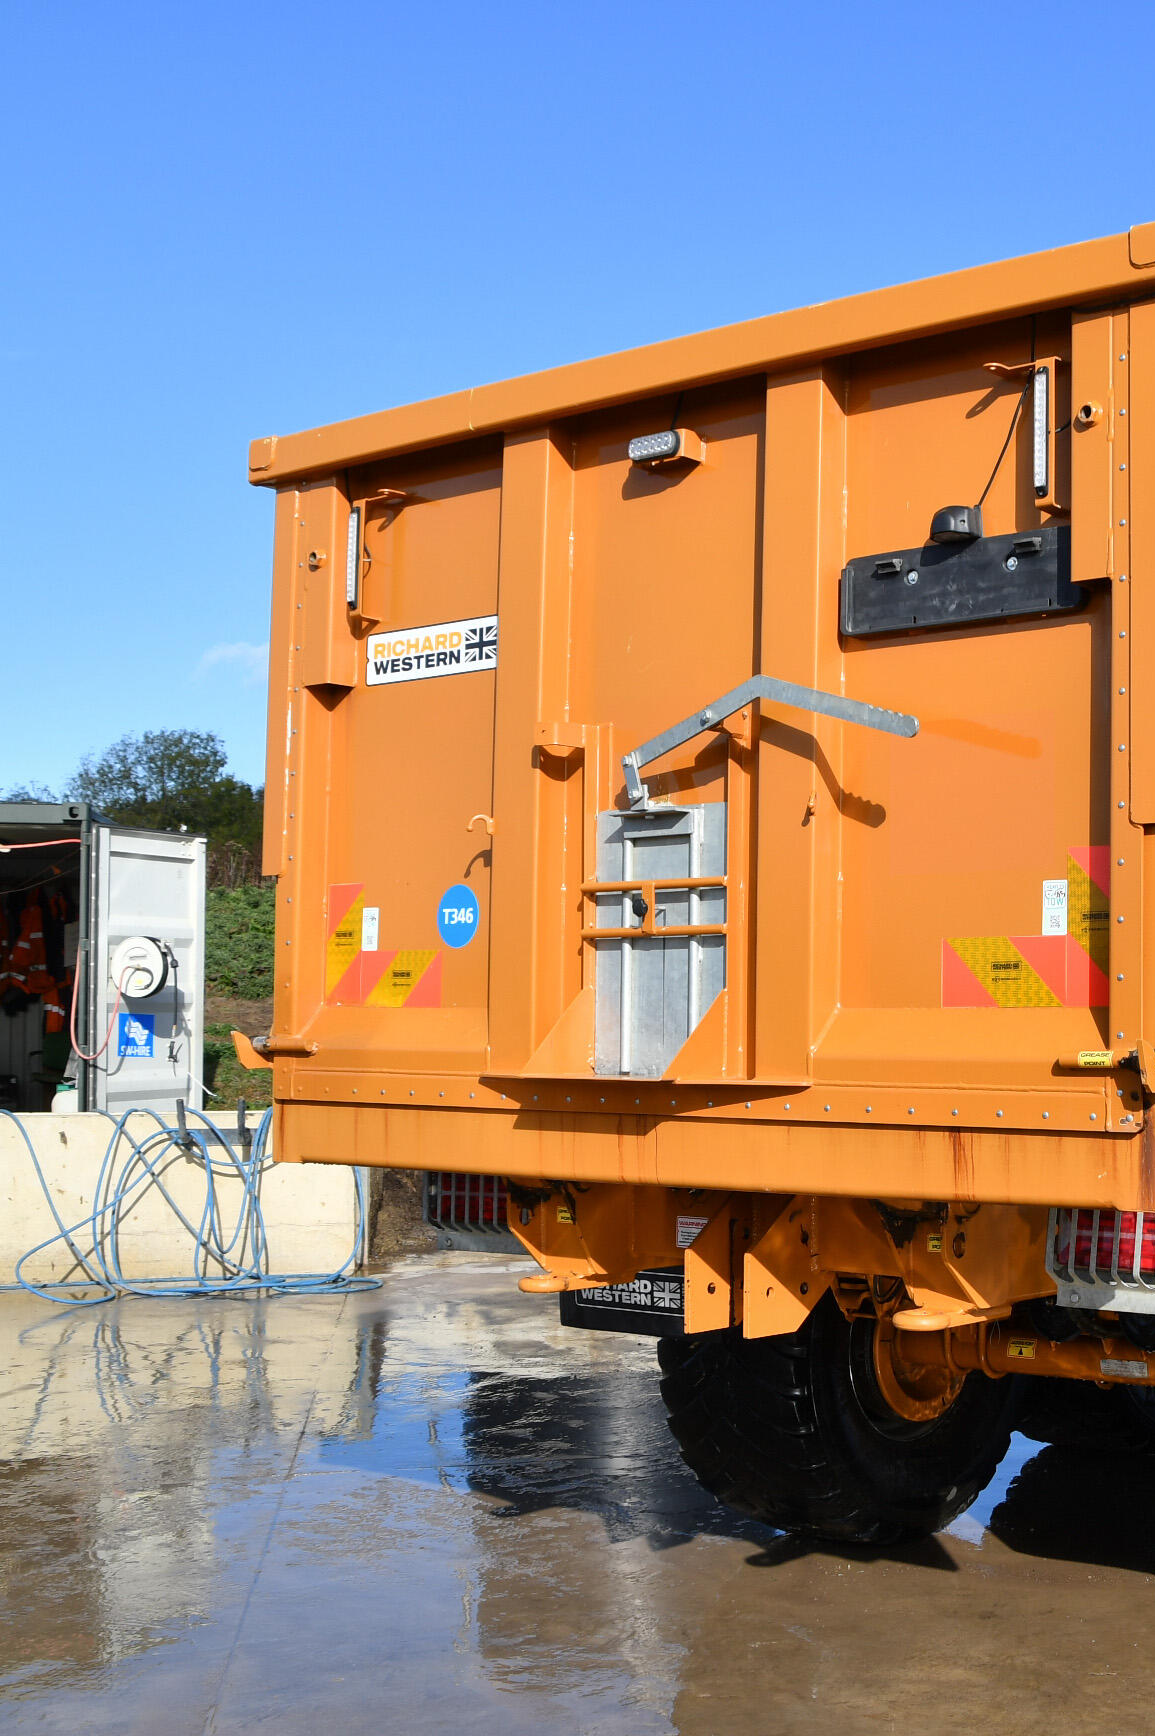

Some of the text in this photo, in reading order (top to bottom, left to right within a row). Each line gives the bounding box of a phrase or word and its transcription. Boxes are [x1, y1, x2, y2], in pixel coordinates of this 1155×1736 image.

[374, 631, 462, 659] RICHARD
[374, 649, 461, 675] WESTERN
[443, 908, 473, 924] T346
[581, 1289, 651, 1305] WESTERN
